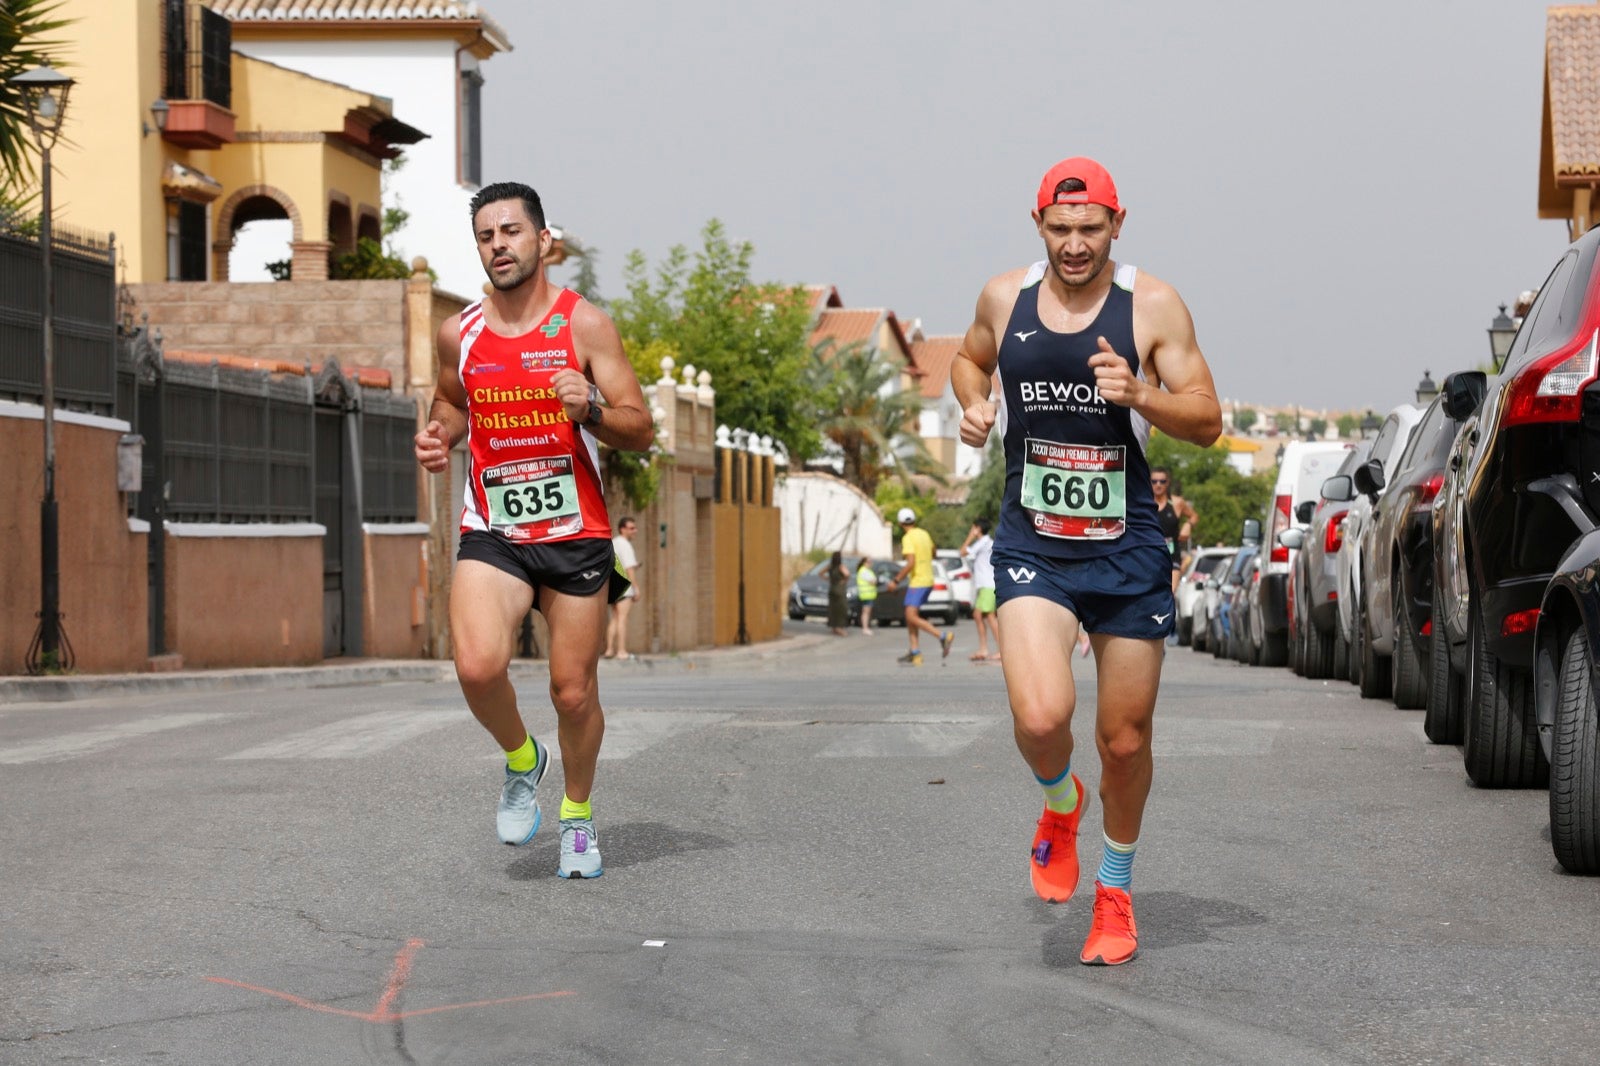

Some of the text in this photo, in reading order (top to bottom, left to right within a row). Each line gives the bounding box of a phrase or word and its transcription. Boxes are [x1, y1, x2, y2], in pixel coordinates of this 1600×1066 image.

[521, 350, 567, 360] MotorDOS
[474, 386, 557, 404] Clínicas
[1024, 404, 1064, 412] SOFTWARE
[1079, 406, 1106, 414] PEOPLE
[475, 408, 568, 429] Polisalud
[490, 434, 549, 450] Continental
[1032, 444, 1048, 456] XXXII
[1049, 446, 1066, 459] GRAN
[1066, 448, 1089, 460] PREMIO
[1090, 450, 1098, 461] DE
[501, 465, 516, 477] GRAN
[517, 462, 538, 474] PREMIO
[539, 460, 546, 470] DE
[504, 481, 564, 518] 635
[1042, 473, 1110, 510] 660
